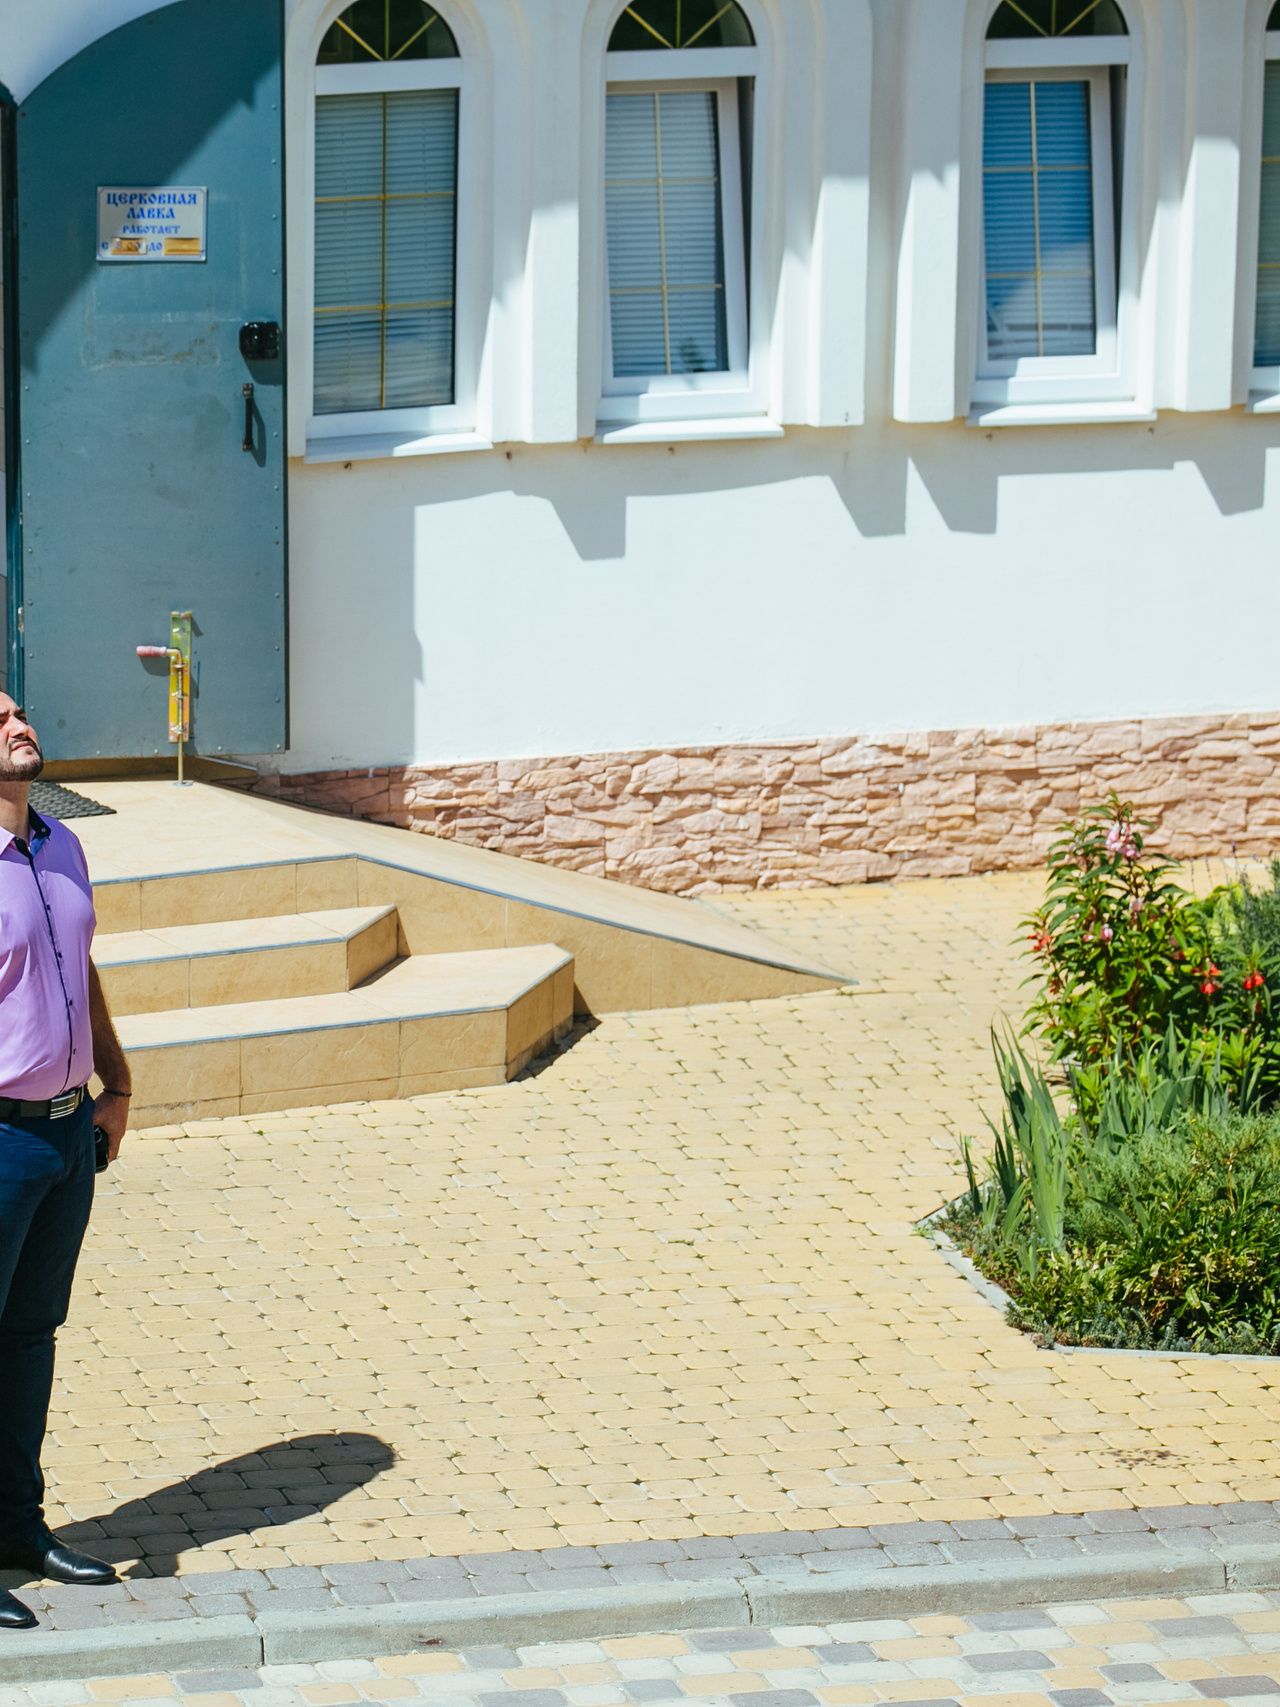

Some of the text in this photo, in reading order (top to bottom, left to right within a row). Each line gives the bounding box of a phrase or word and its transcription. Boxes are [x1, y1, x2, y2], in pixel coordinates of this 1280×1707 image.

[106, 193, 197, 207] ЦЕРКОВНАЯ
[126, 207, 175, 219] ЛАВКА
[122, 225, 181, 234] РАБОТАЕТ
[148, 242, 163, 252] ДО
